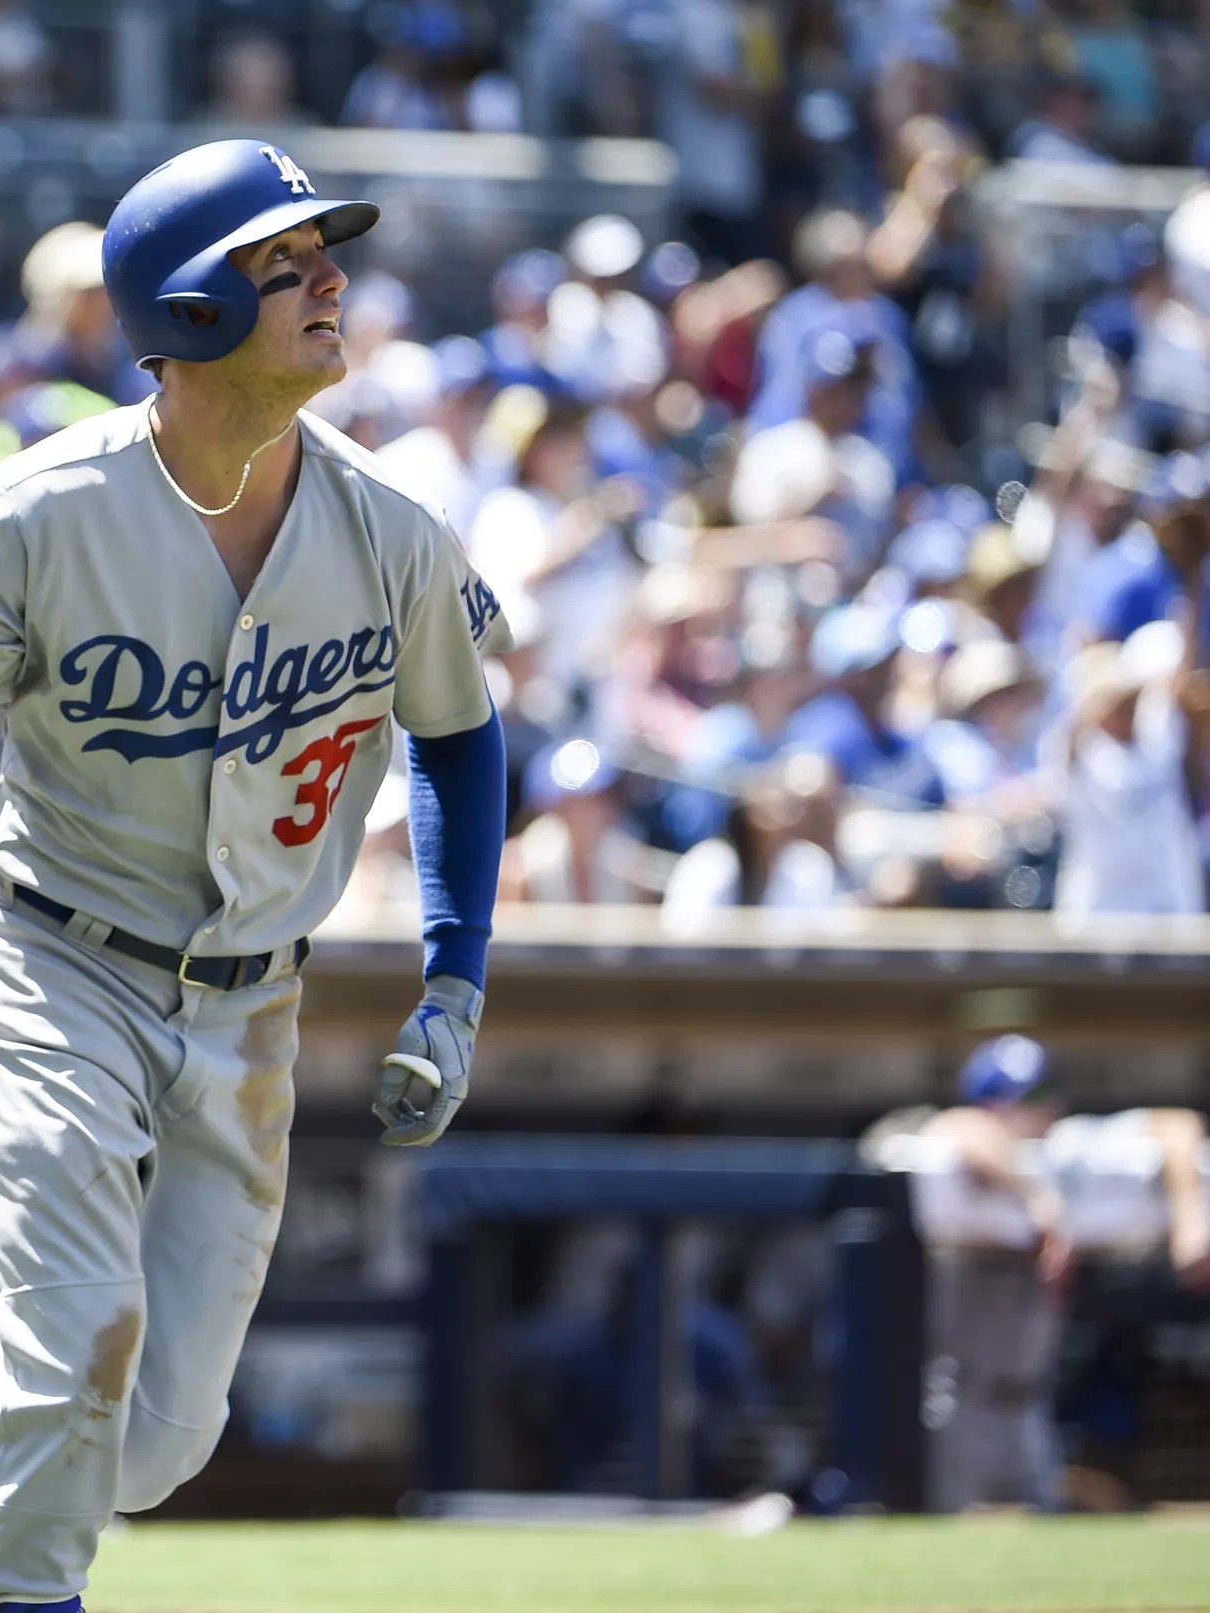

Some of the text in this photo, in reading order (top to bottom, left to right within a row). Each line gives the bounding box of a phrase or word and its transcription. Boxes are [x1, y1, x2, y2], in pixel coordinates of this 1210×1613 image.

[258, 145, 316, 194] LA
[460, 574, 501, 642] LA
[59, 622, 396, 765] Dodgers
